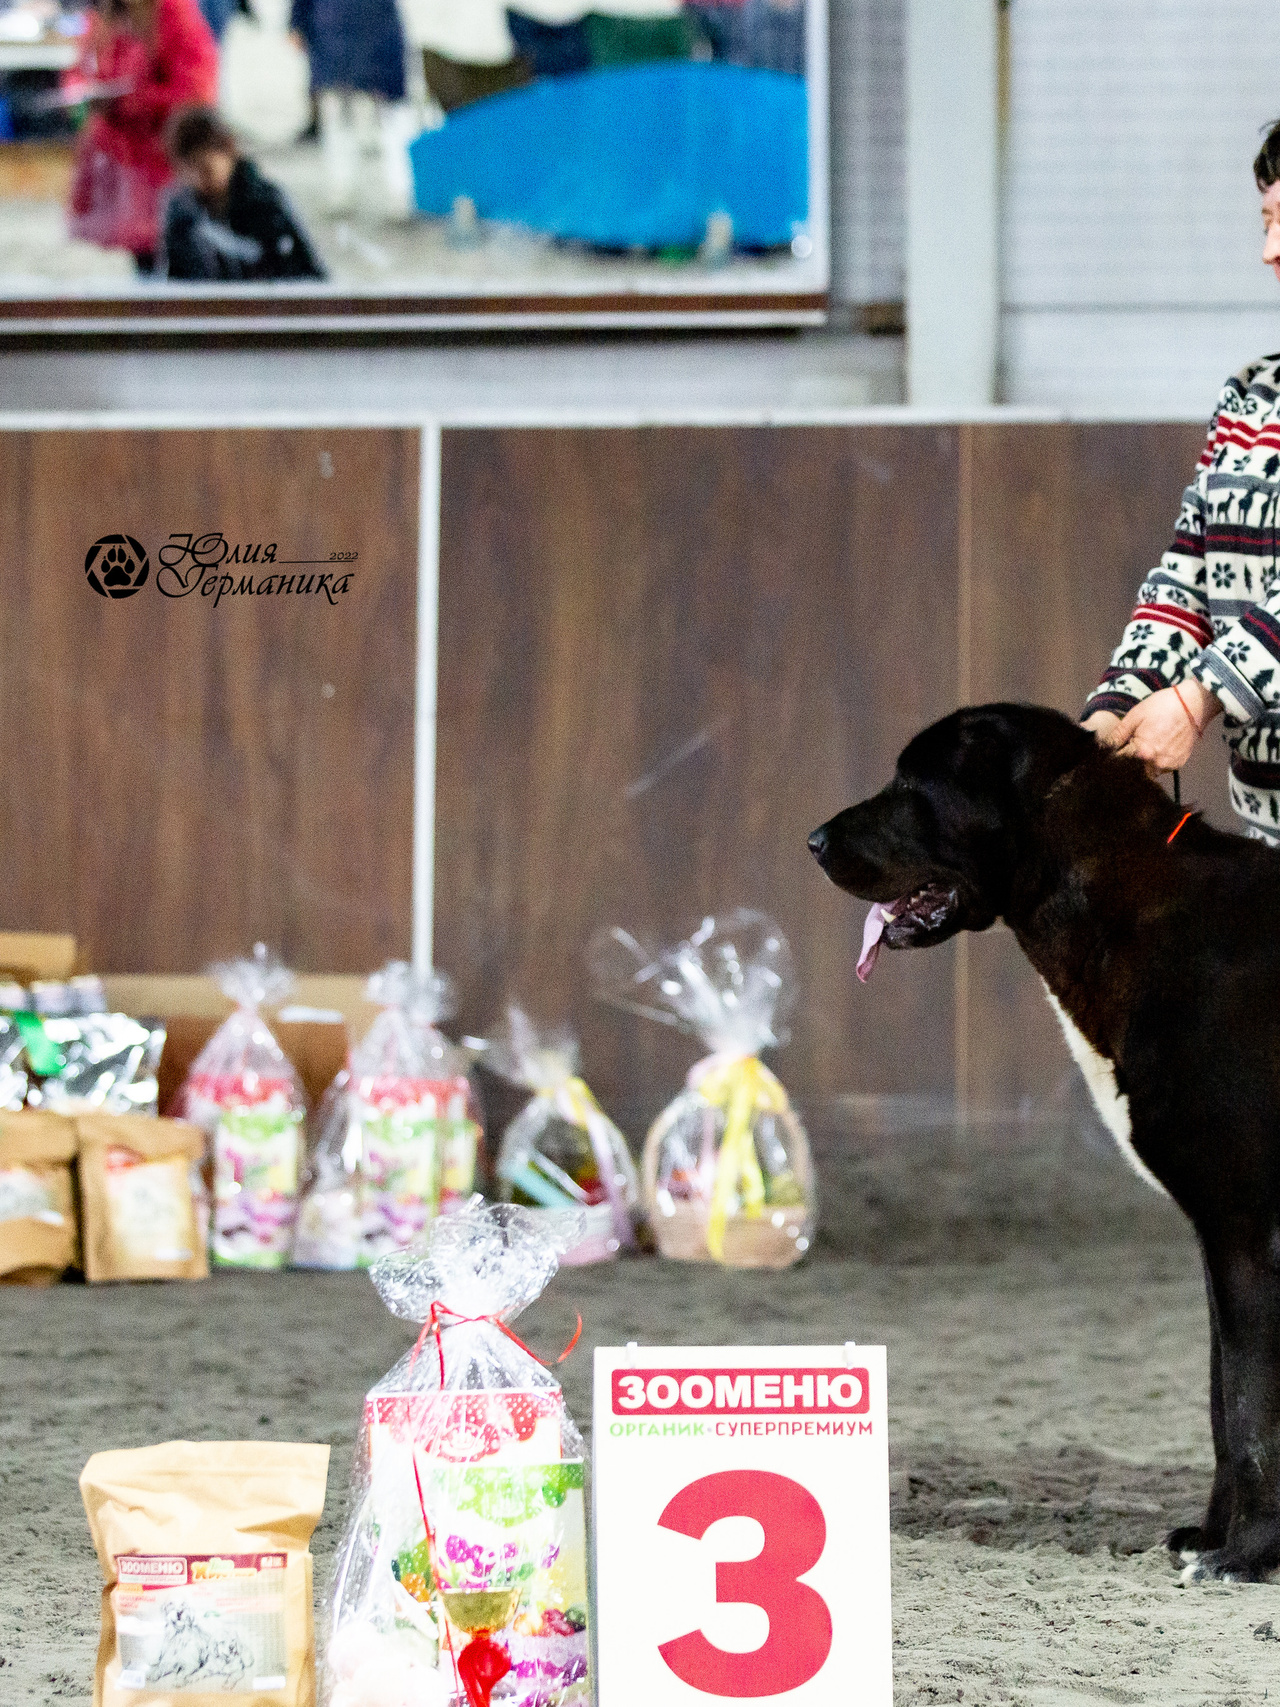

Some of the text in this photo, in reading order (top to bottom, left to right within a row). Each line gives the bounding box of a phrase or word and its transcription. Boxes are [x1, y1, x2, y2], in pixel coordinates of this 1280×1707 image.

[617, 1374, 863, 1409] ЗООМЕНЮ
[609, 1421, 873, 1437] ОРГАНИК СУПЕРПРЕМИУМ
[656, 1469, 833, 1698] 3
